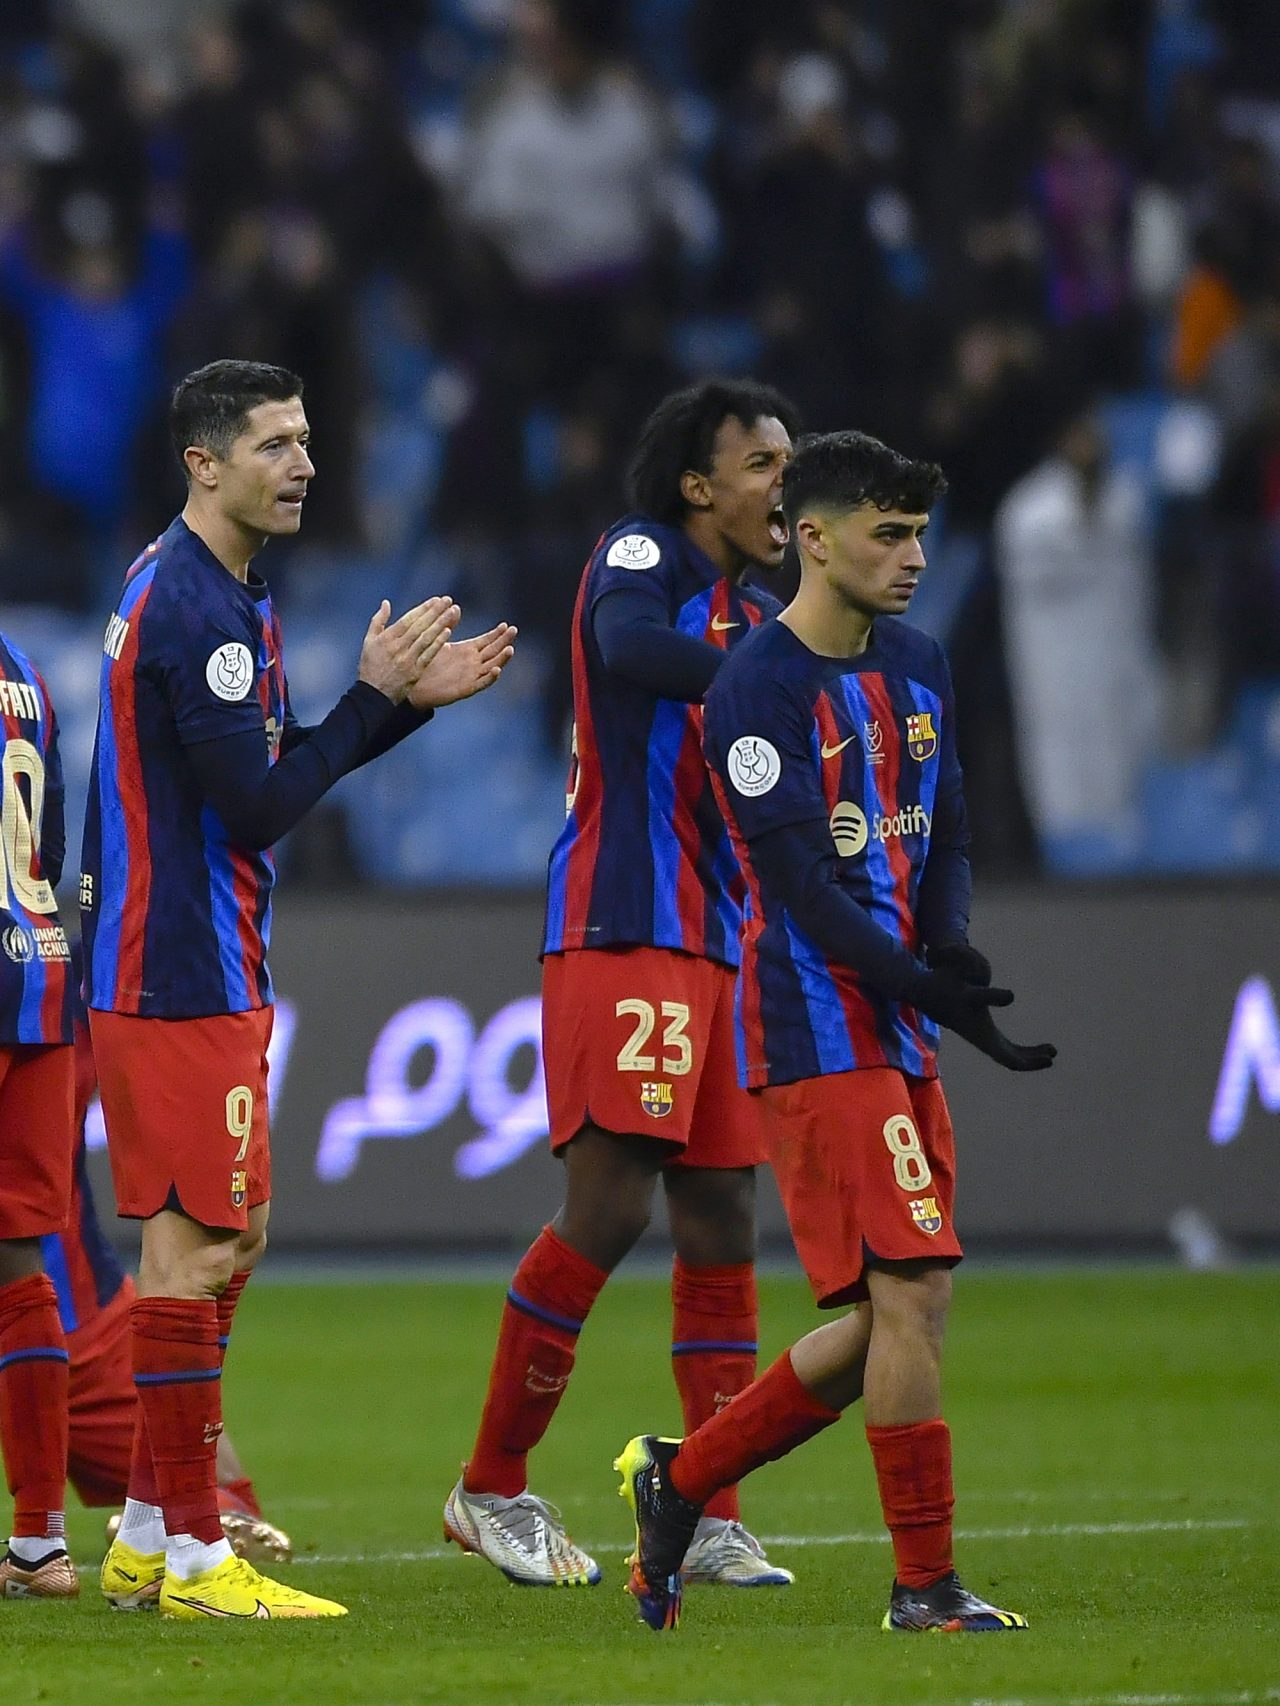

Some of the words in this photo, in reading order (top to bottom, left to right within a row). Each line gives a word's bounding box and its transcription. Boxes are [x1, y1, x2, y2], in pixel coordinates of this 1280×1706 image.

[872, 805, 932, 844] Spotify
[615, 998, 693, 1076] 23
[225, 1085, 253, 1162] 9
[882, 1113, 932, 1192] 8
